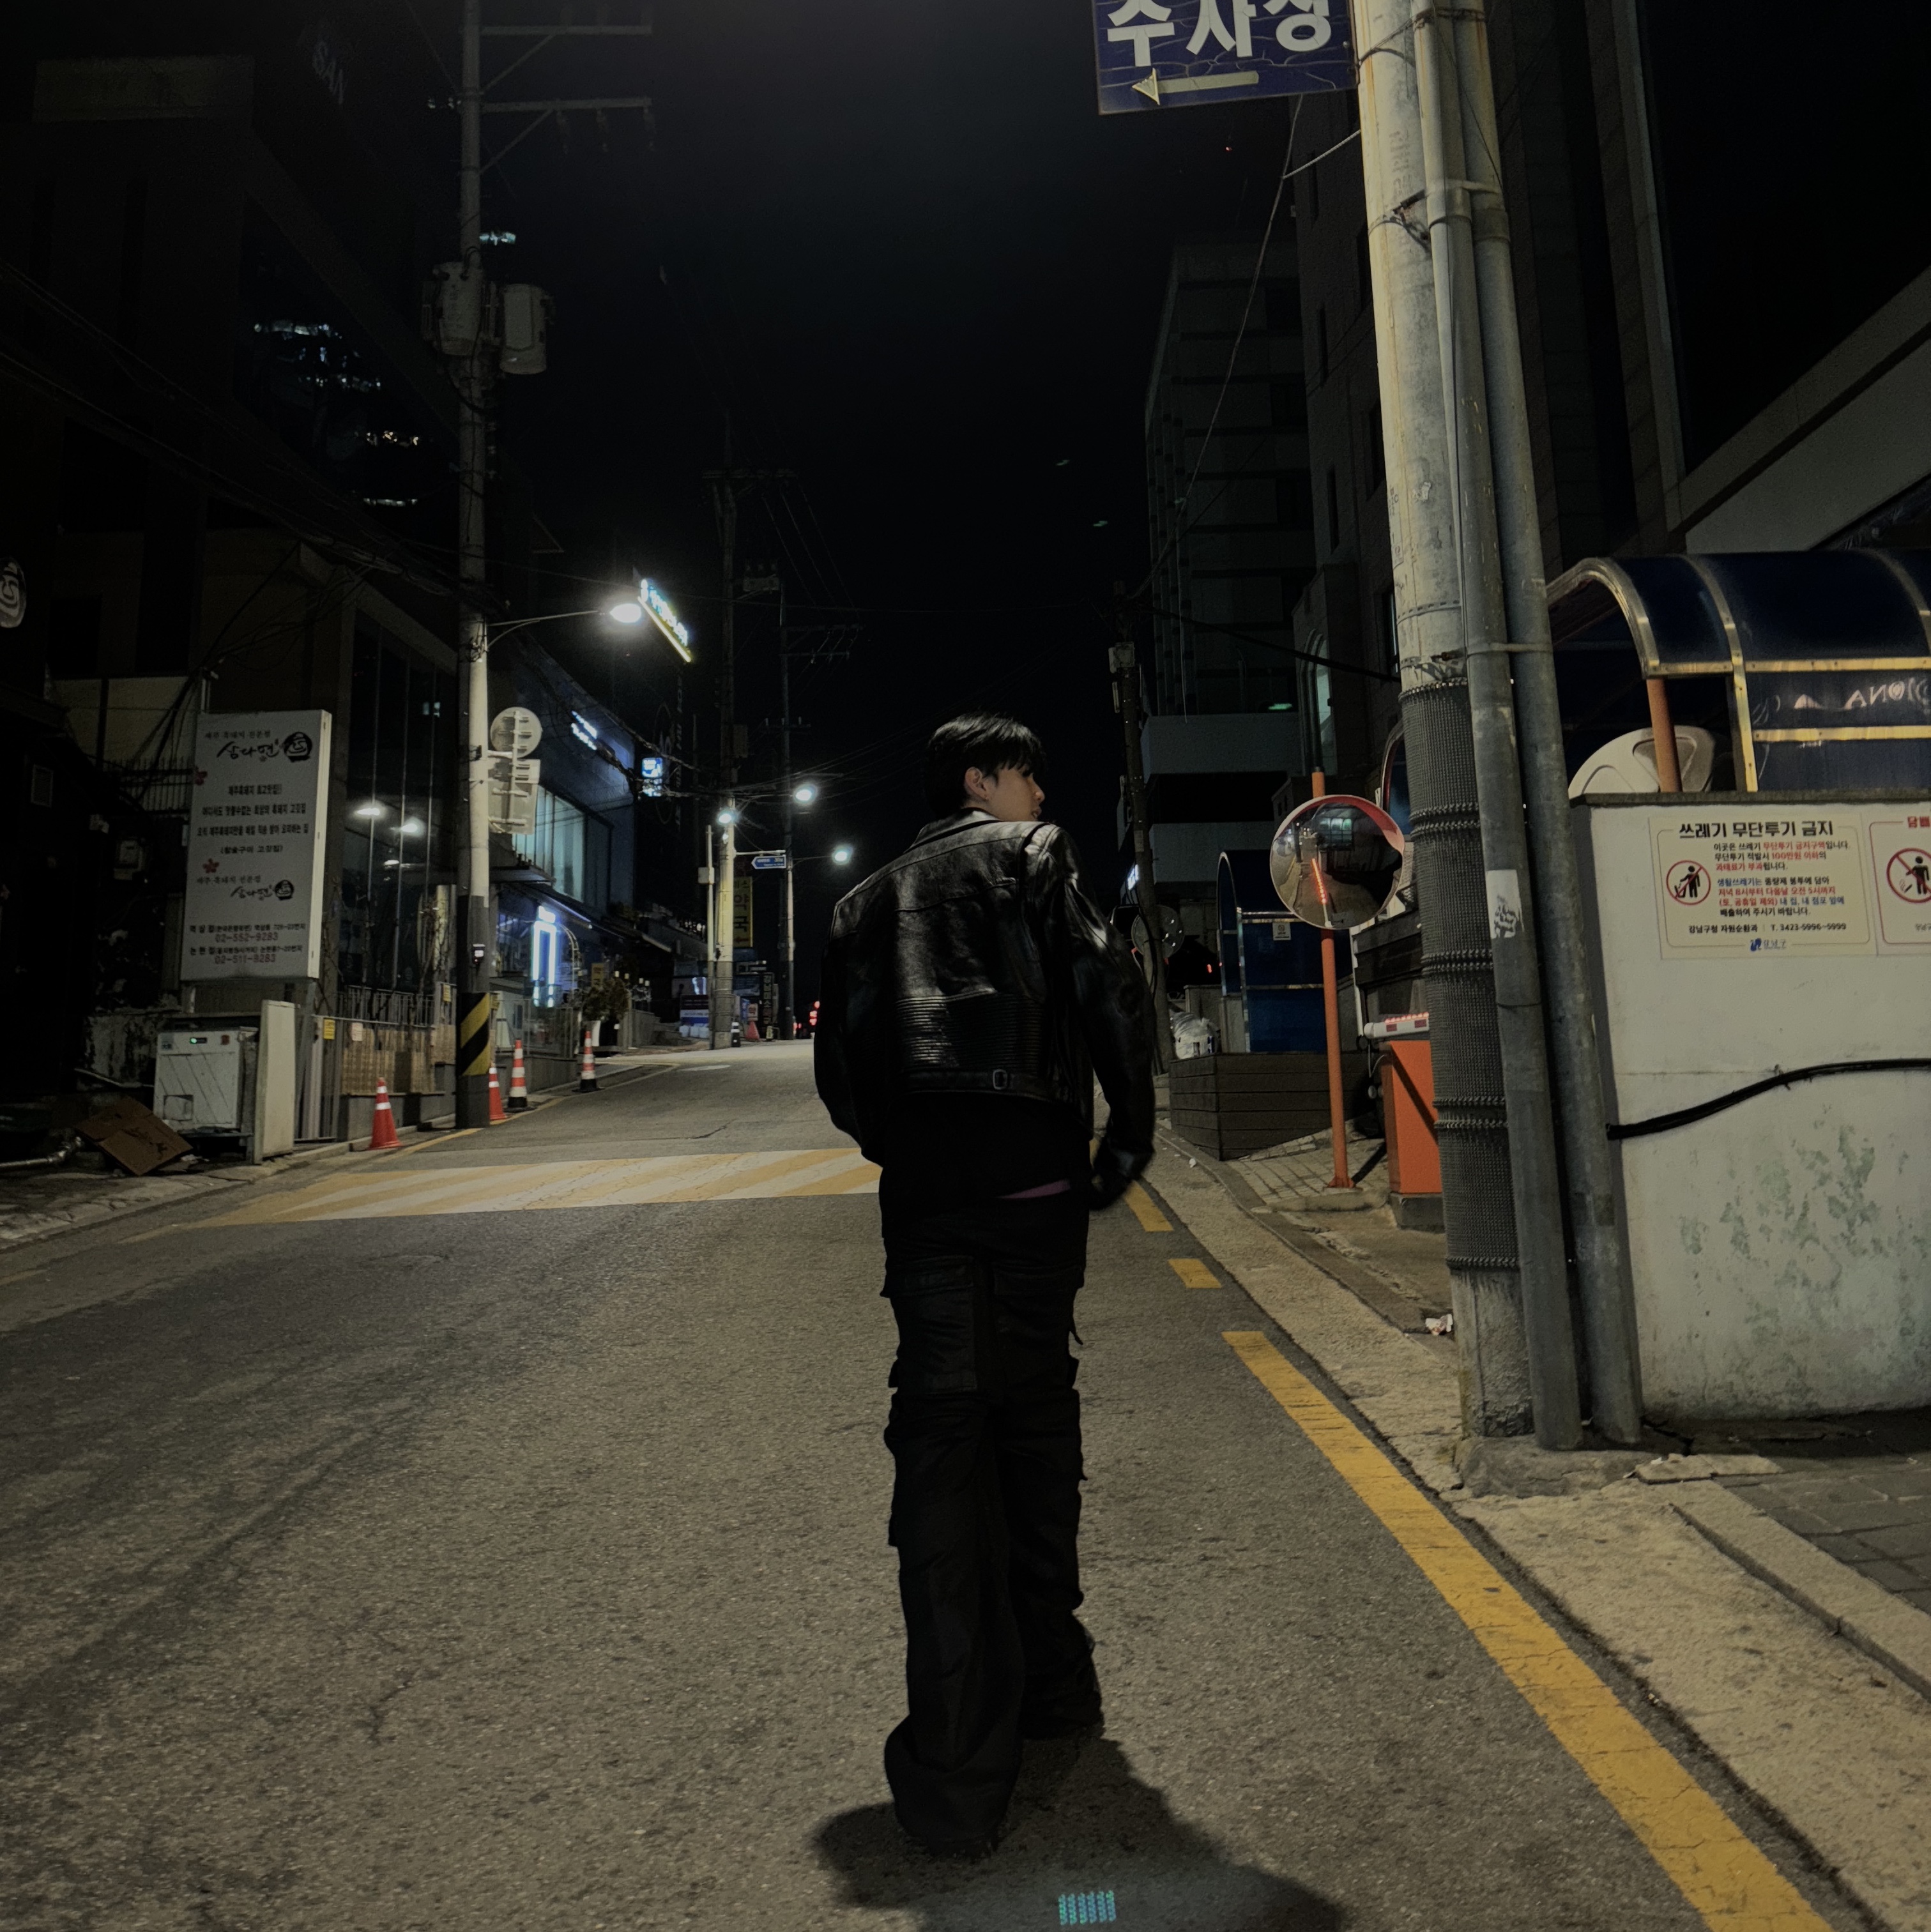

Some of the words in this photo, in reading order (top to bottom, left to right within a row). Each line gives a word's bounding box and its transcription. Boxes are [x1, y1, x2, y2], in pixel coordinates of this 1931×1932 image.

[1679, 823, 1727, 838] 쓰레기
[1733, 821, 1796, 837] 무단투기
[1802, 821, 1833, 836] 금지
[1739, 842, 1760, 851] 쓰레기
[1763, 842, 1792, 851] 무단투기
[1715, 853, 1744, 861] 무단투기
[1804, 851, 1826, 860] 이하의
[1716, 863, 1744, 871] 과태료가
[1718, 878, 1762, 886] 생활쓰레기는
[1815, 876, 1829, 885] 담아
[1802, 897, 1809, 905] 내
[1753, 908, 1775, 916] 주시기
